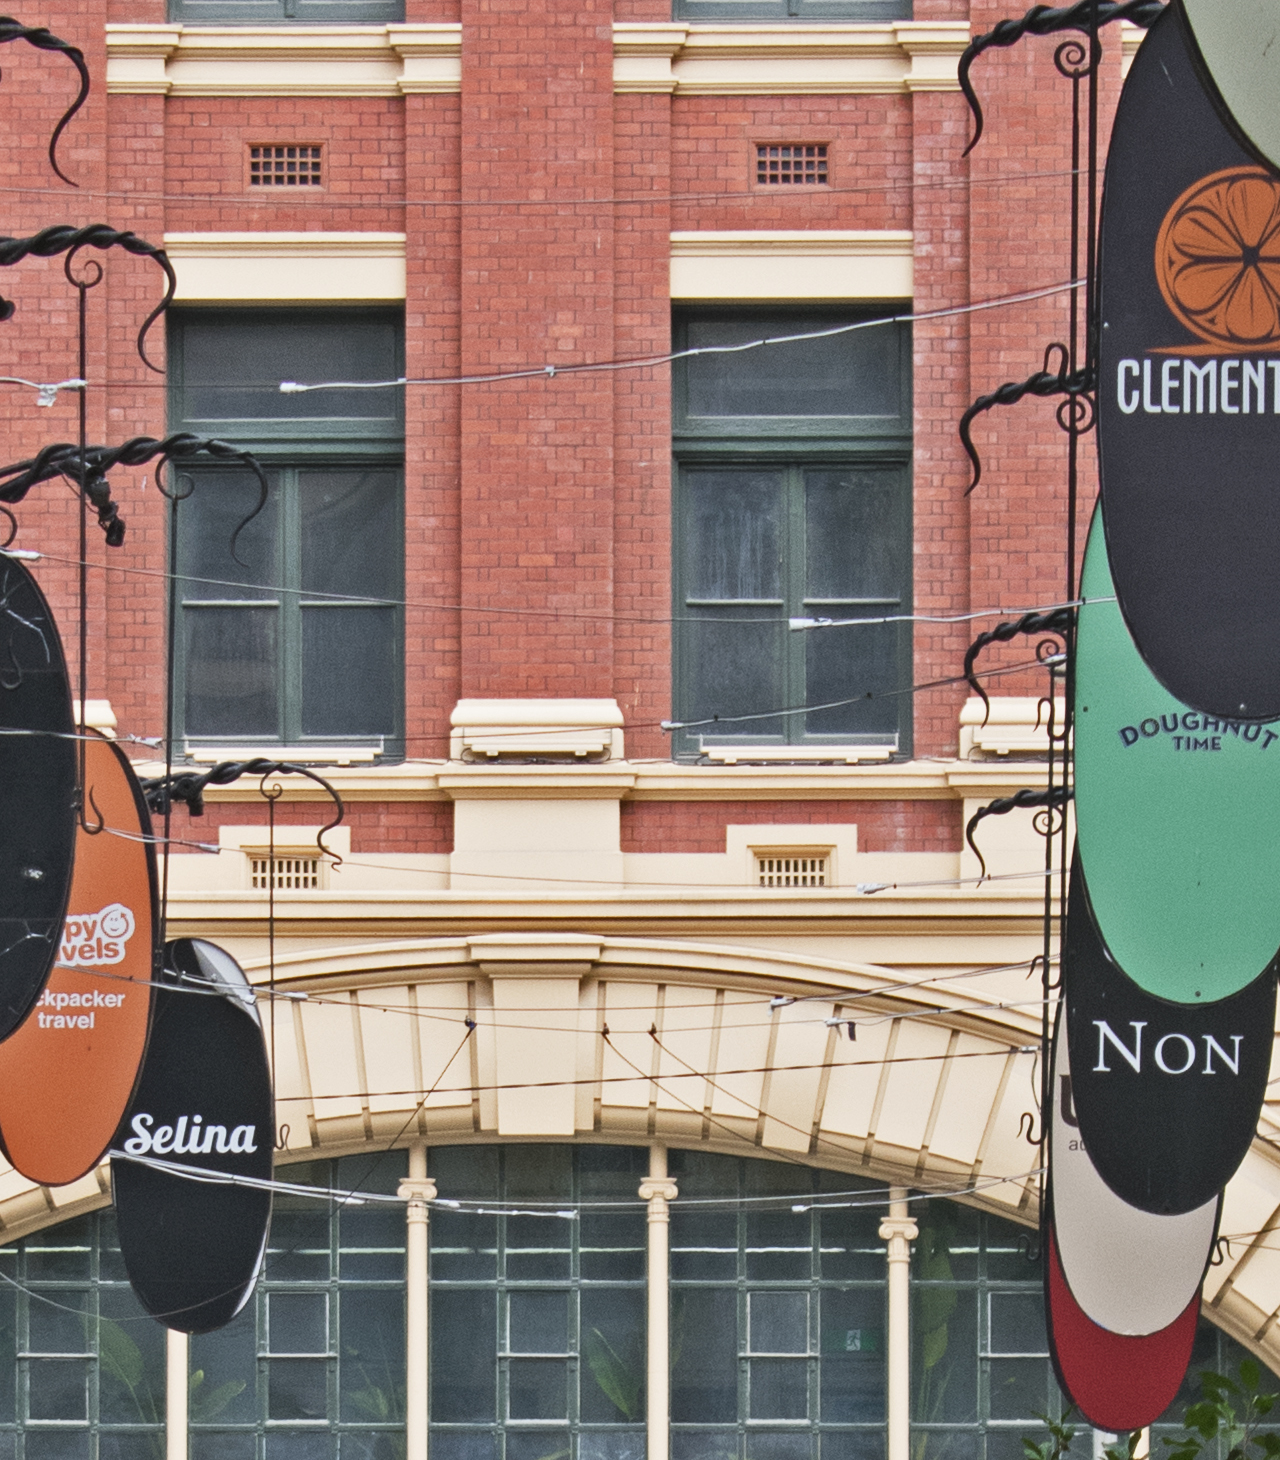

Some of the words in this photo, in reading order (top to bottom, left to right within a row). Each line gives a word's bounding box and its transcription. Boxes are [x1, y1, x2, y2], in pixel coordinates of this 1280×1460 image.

[1119, 711, 1279, 750] DOUGHNUT
[1172, 735, 1222, 751] TIME
[58, 937, 120, 962] vels
[35, 989, 126, 1011] ckpacker
[38, 1012, 95, 1029] travel
[124, 1112, 258, 1154] Selina
